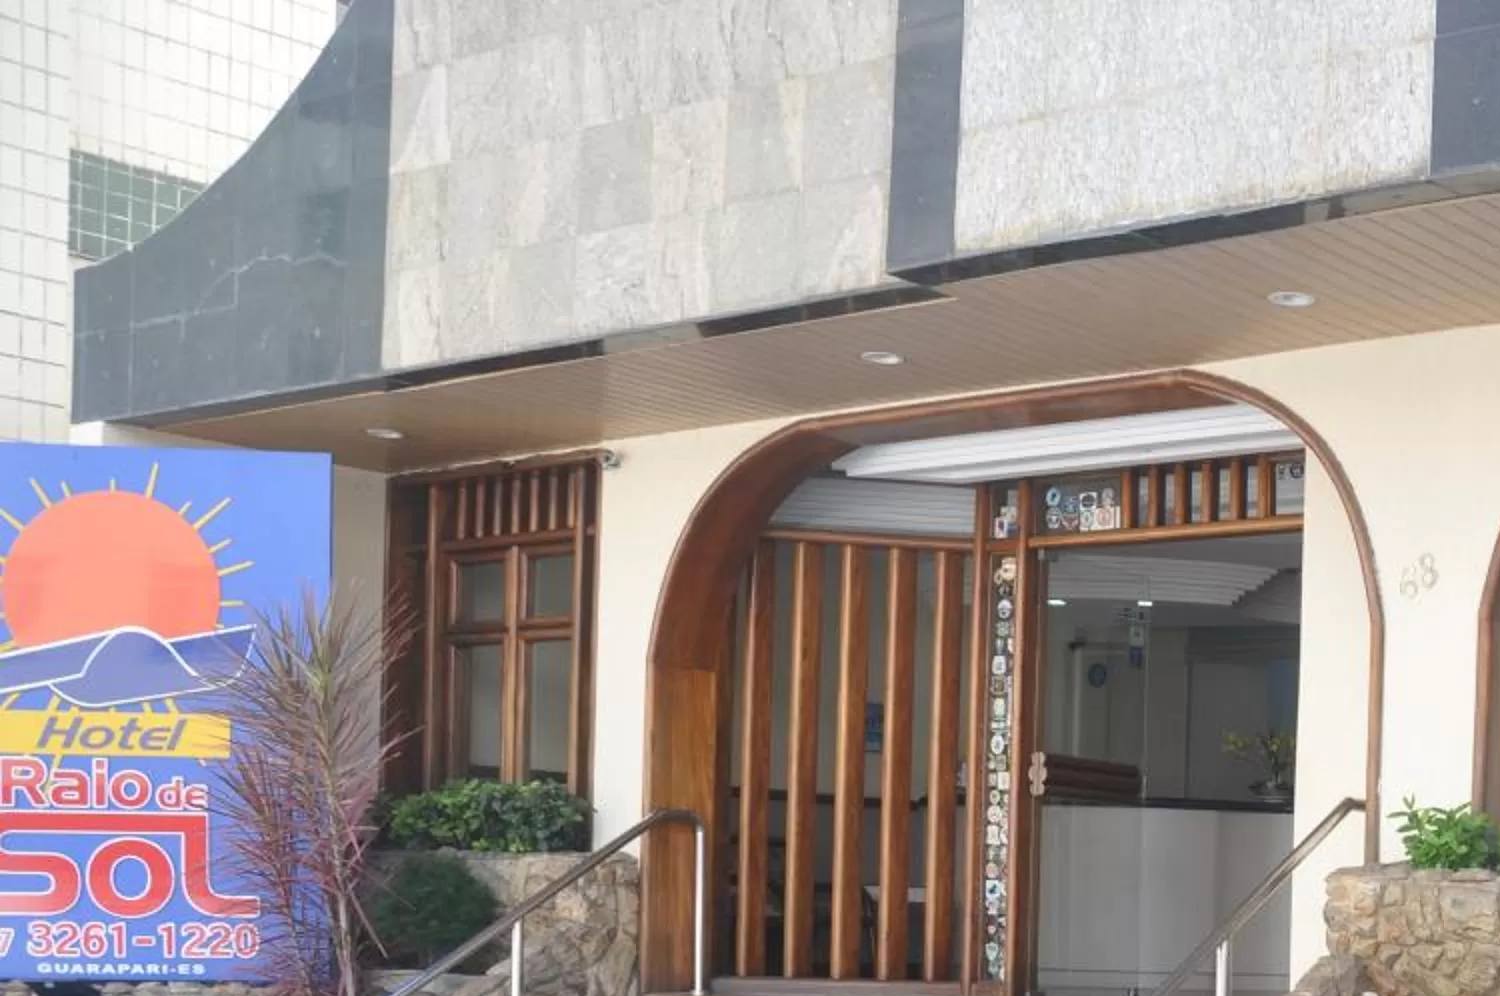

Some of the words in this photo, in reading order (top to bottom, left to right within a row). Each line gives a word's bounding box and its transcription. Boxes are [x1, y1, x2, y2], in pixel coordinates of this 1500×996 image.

[37, 716, 188, 751] Hotel
[0, 756, 152, 810] Raio
[155, 776, 208, 810] de
[27, 920, 261, 960] 3261-1220
[37, 961, 206, 976] GUARAPARI-ES
